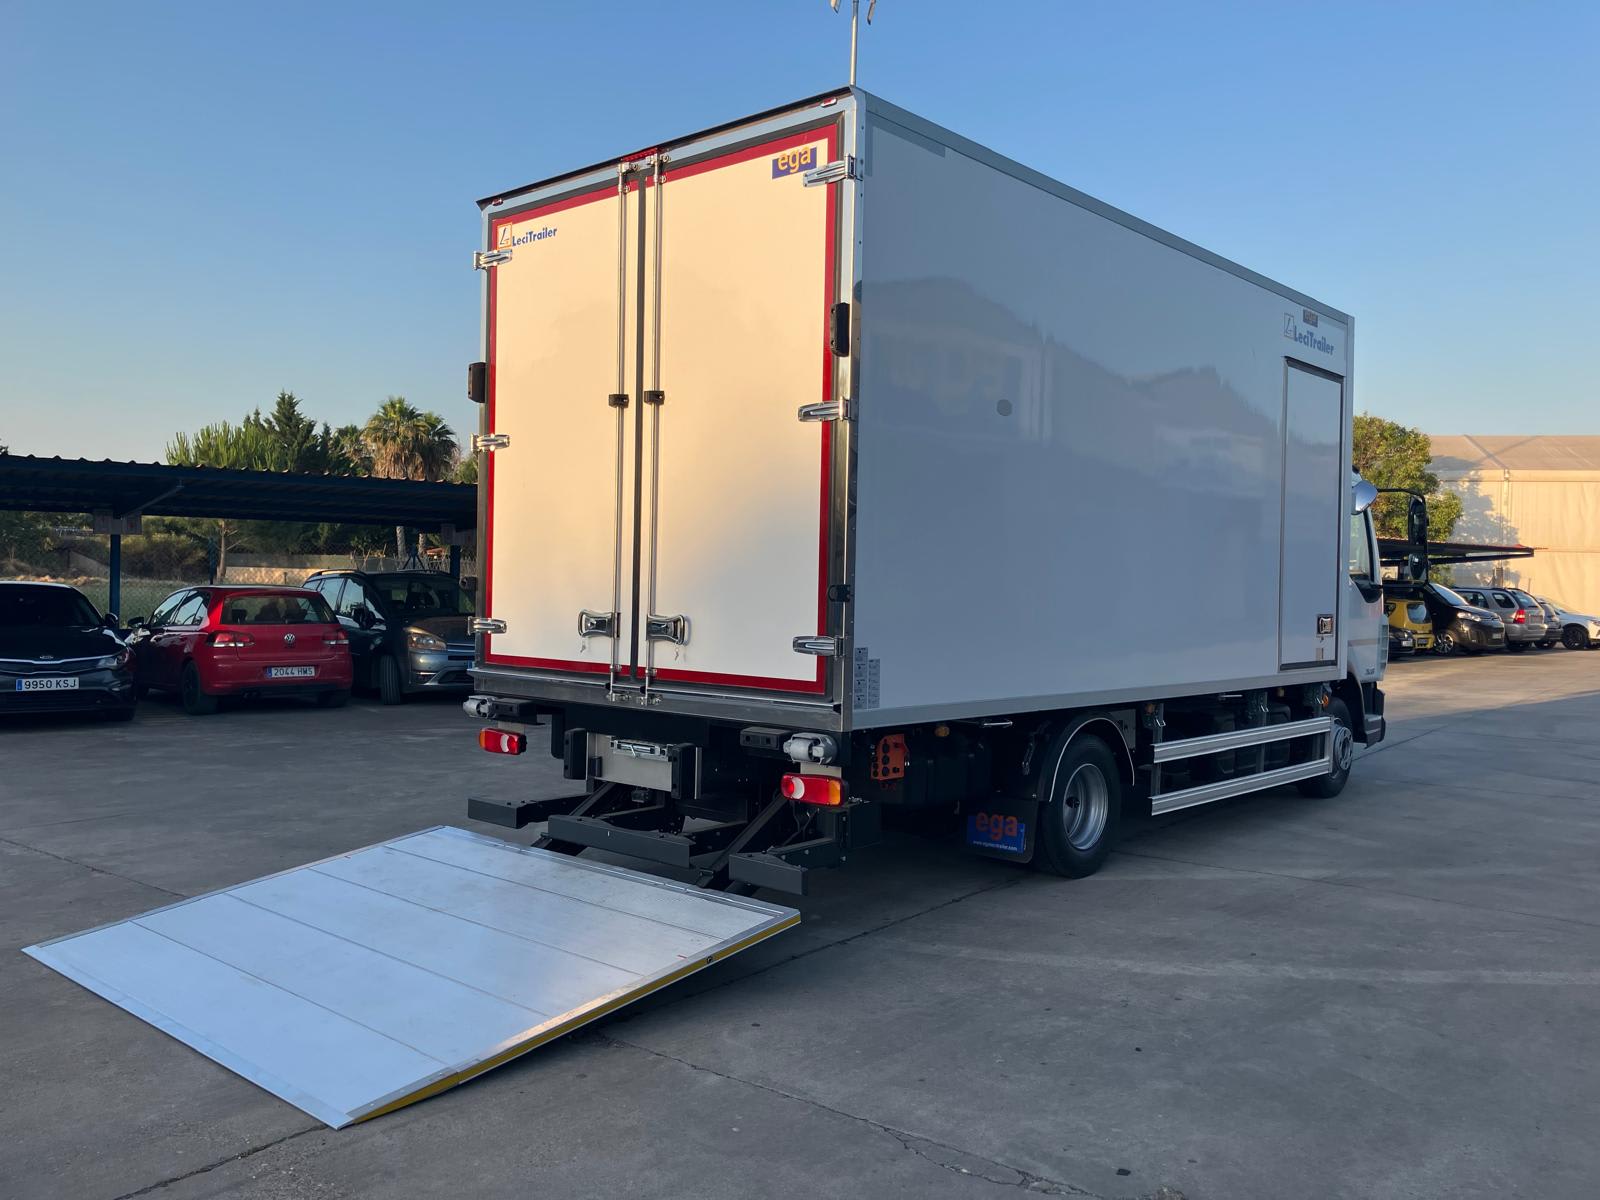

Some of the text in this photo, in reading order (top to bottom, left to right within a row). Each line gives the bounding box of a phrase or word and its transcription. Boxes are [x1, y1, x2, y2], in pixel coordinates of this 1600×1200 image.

[777, 146, 811, 173] ega
[512, 227, 558, 247] LeciTrailer
[1294, 325, 1334, 356] LeciTrailer
[274, 668, 295, 676] 2044
[24, 679, 76, 690] 9950 KSJ
[975, 812, 1018, 842] ega
